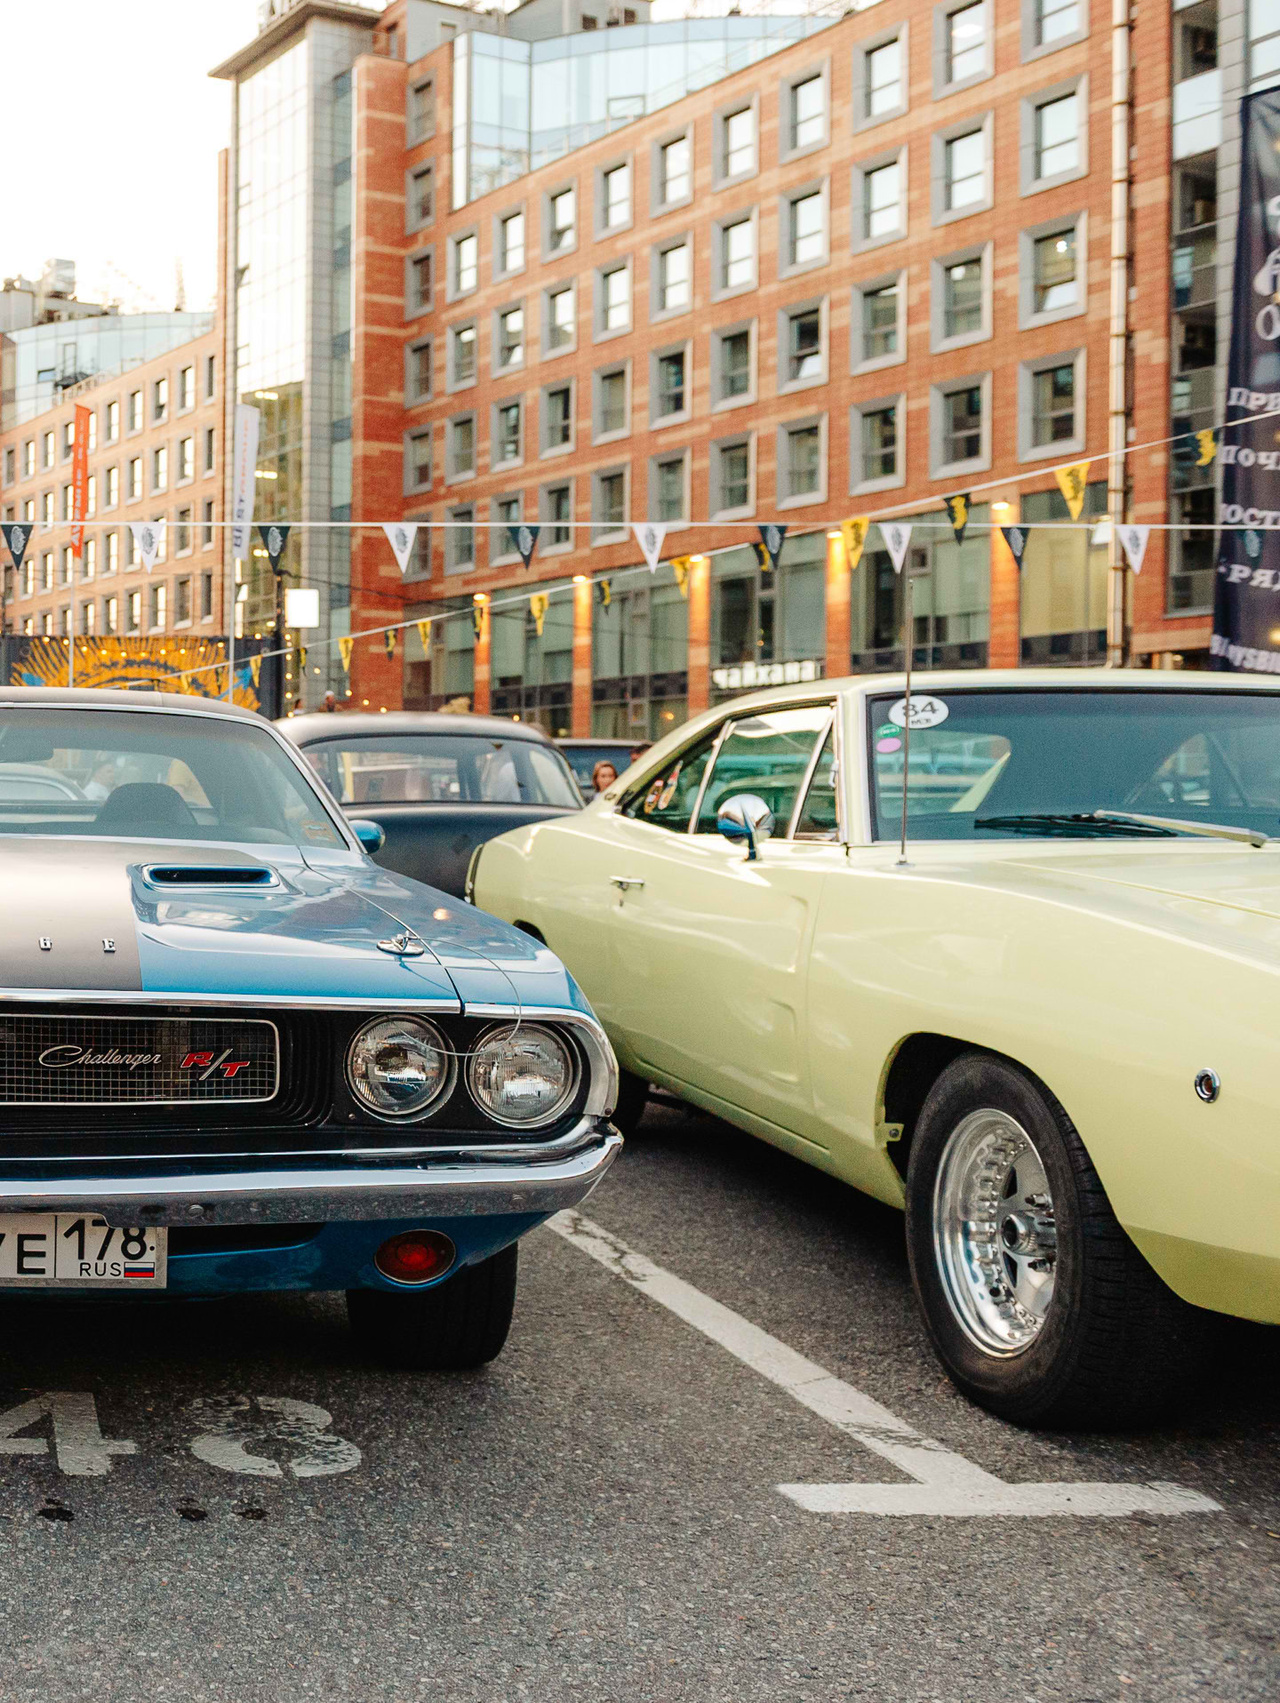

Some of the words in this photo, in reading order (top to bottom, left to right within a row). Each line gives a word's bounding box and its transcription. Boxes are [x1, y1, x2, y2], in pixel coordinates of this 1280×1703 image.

[712, 661, 816, 689] чайхана
[38, 1045, 162, 1071] Challenger
[180, 1049, 250, 1081] R/T
[63, 1218, 147, 1261] 178
[79, 1261, 121, 1277] RUS
